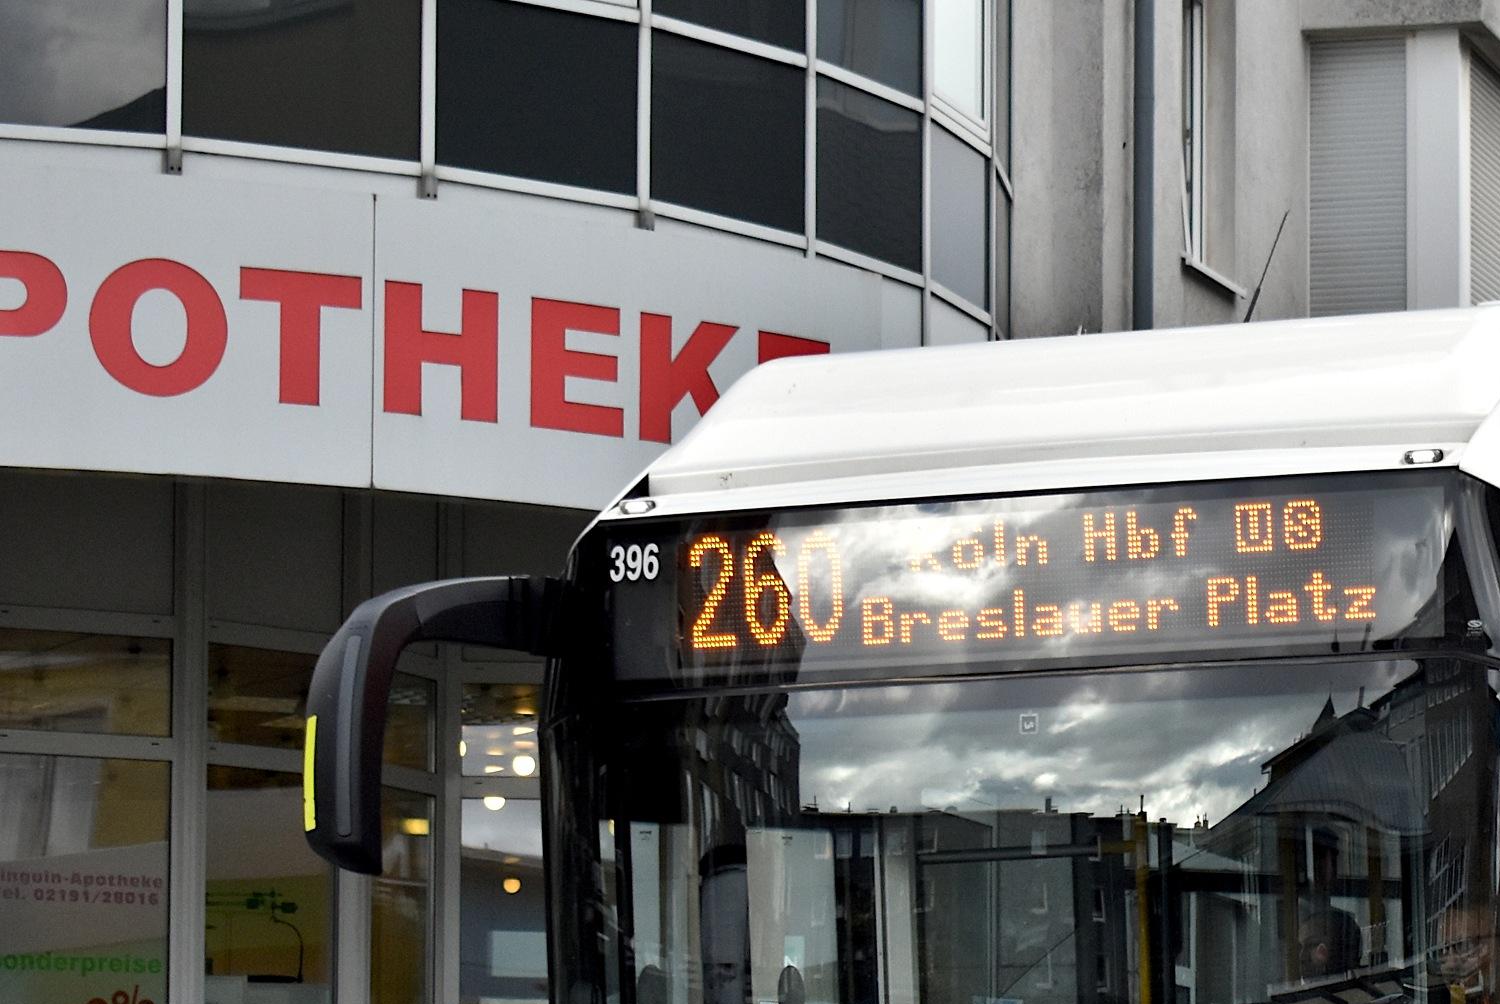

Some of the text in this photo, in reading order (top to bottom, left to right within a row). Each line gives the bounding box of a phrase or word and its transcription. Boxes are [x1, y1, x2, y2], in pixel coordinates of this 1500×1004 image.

[0, 250, 831, 444] POTHEK
[609, 543, 660, 583] 396
[1082, 507, 1198, 563] Hbf
[689, 530, 844, 649] 260
[861, 572, 1377, 646] Breslauer Platz
[0, 887, 26, 900] el.
[0, 951, 162, 976] onderpreise
